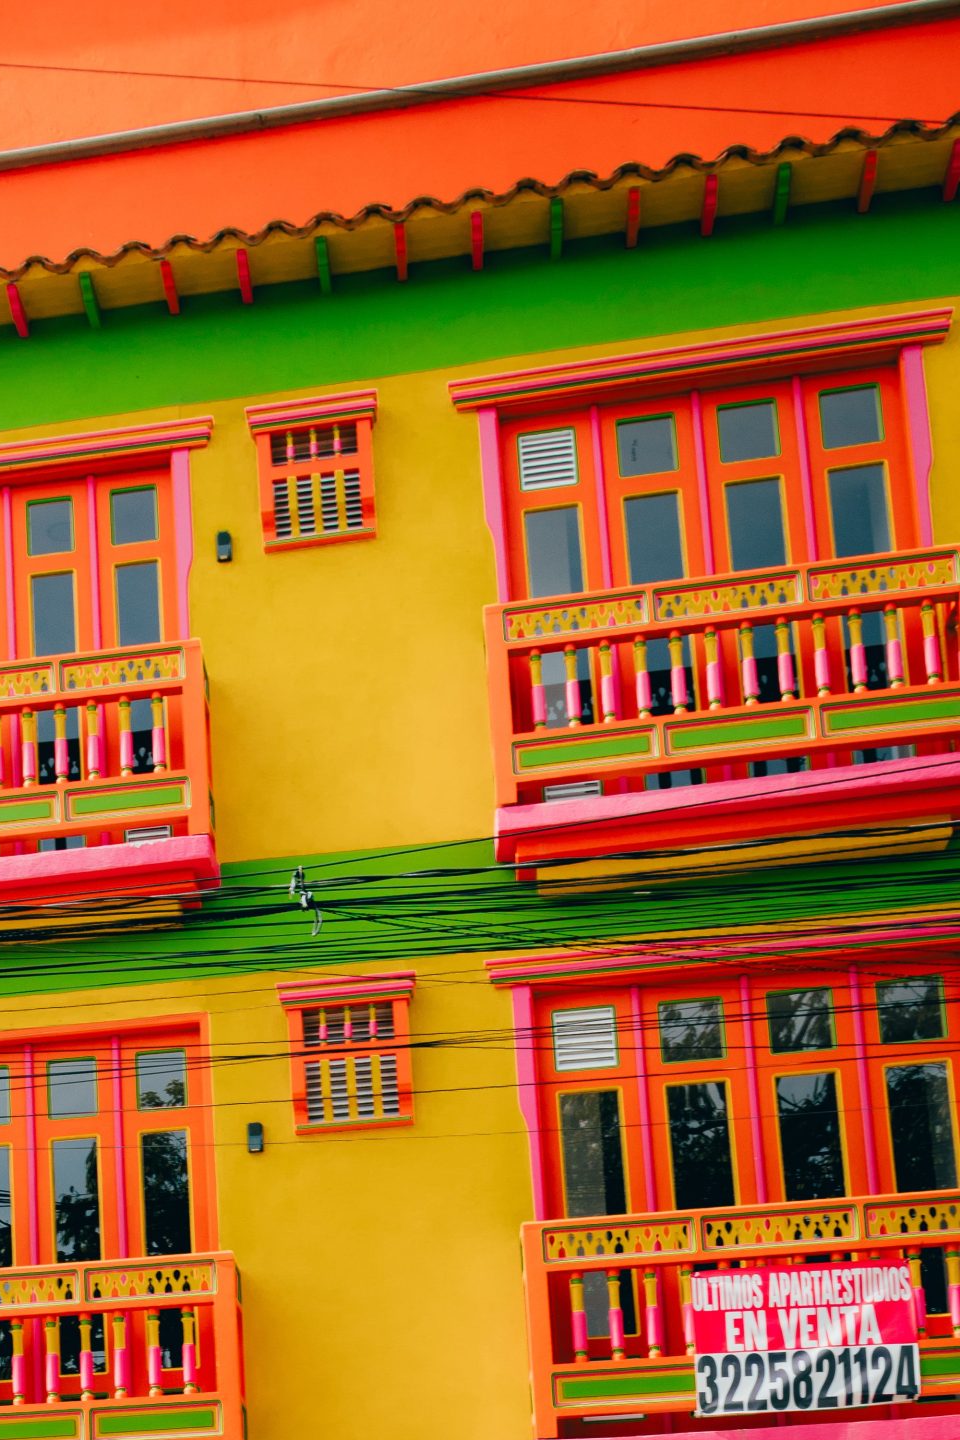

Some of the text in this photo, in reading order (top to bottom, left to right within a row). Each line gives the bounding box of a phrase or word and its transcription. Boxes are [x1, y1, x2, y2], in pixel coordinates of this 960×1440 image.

[769, 1266, 913, 1308] APARTAESTUDIOS
[725, 1303, 883, 1351] EN VENTA
[696, 1344, 919, 1414] 3225821124
